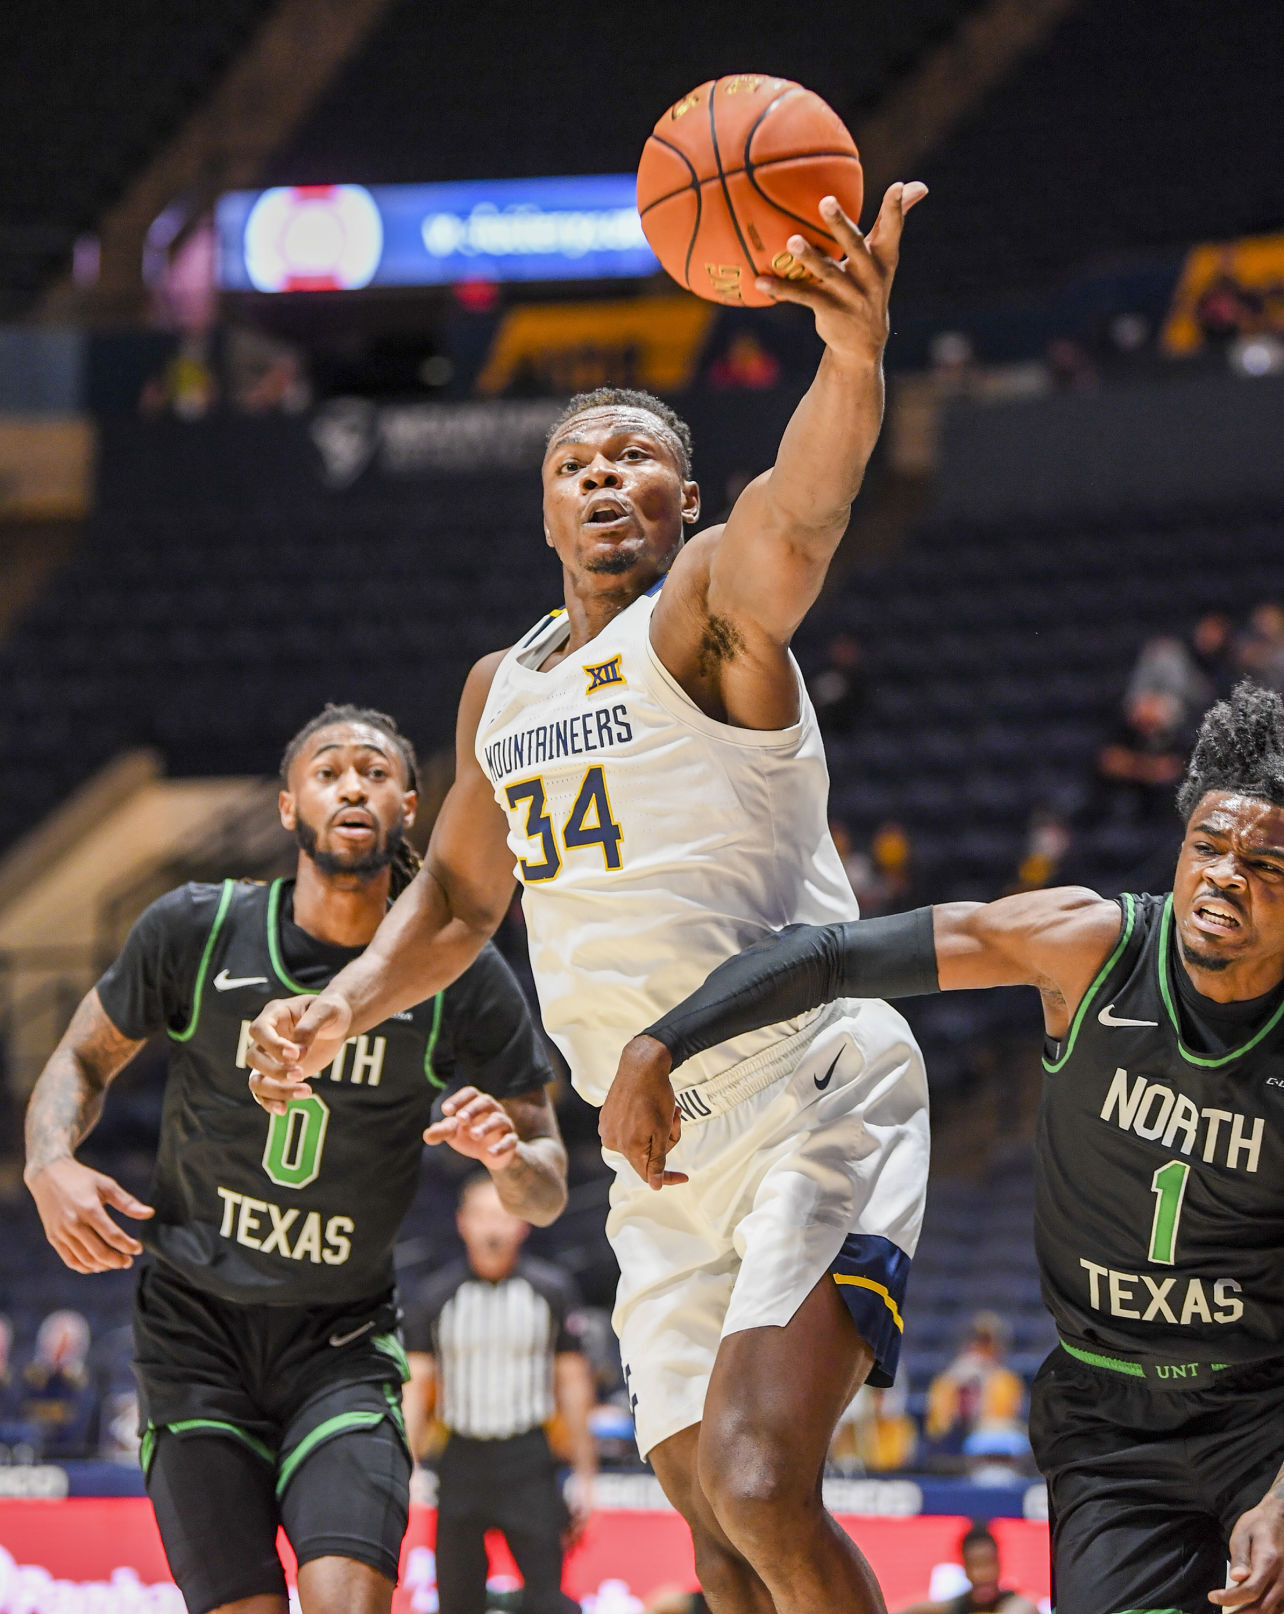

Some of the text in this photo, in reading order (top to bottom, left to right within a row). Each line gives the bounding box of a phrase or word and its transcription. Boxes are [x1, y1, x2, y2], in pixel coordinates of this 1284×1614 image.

[586, 657, 623, 691] XII
[484, 704, 633, 784] MOUNTAINEERS
[504, 764, 624, 884] 34
[261, 1092, 330, 1190] 0
[1100, 1067, 1265, 1173] NORTH
[217, 1186, 355, 1265] TEXAS
[1147, 1160, 1191, 1265] 1
[1080, 1257, 1244, 1325] TEXAS
[1155, 1362, 1199, 1380] UNT
